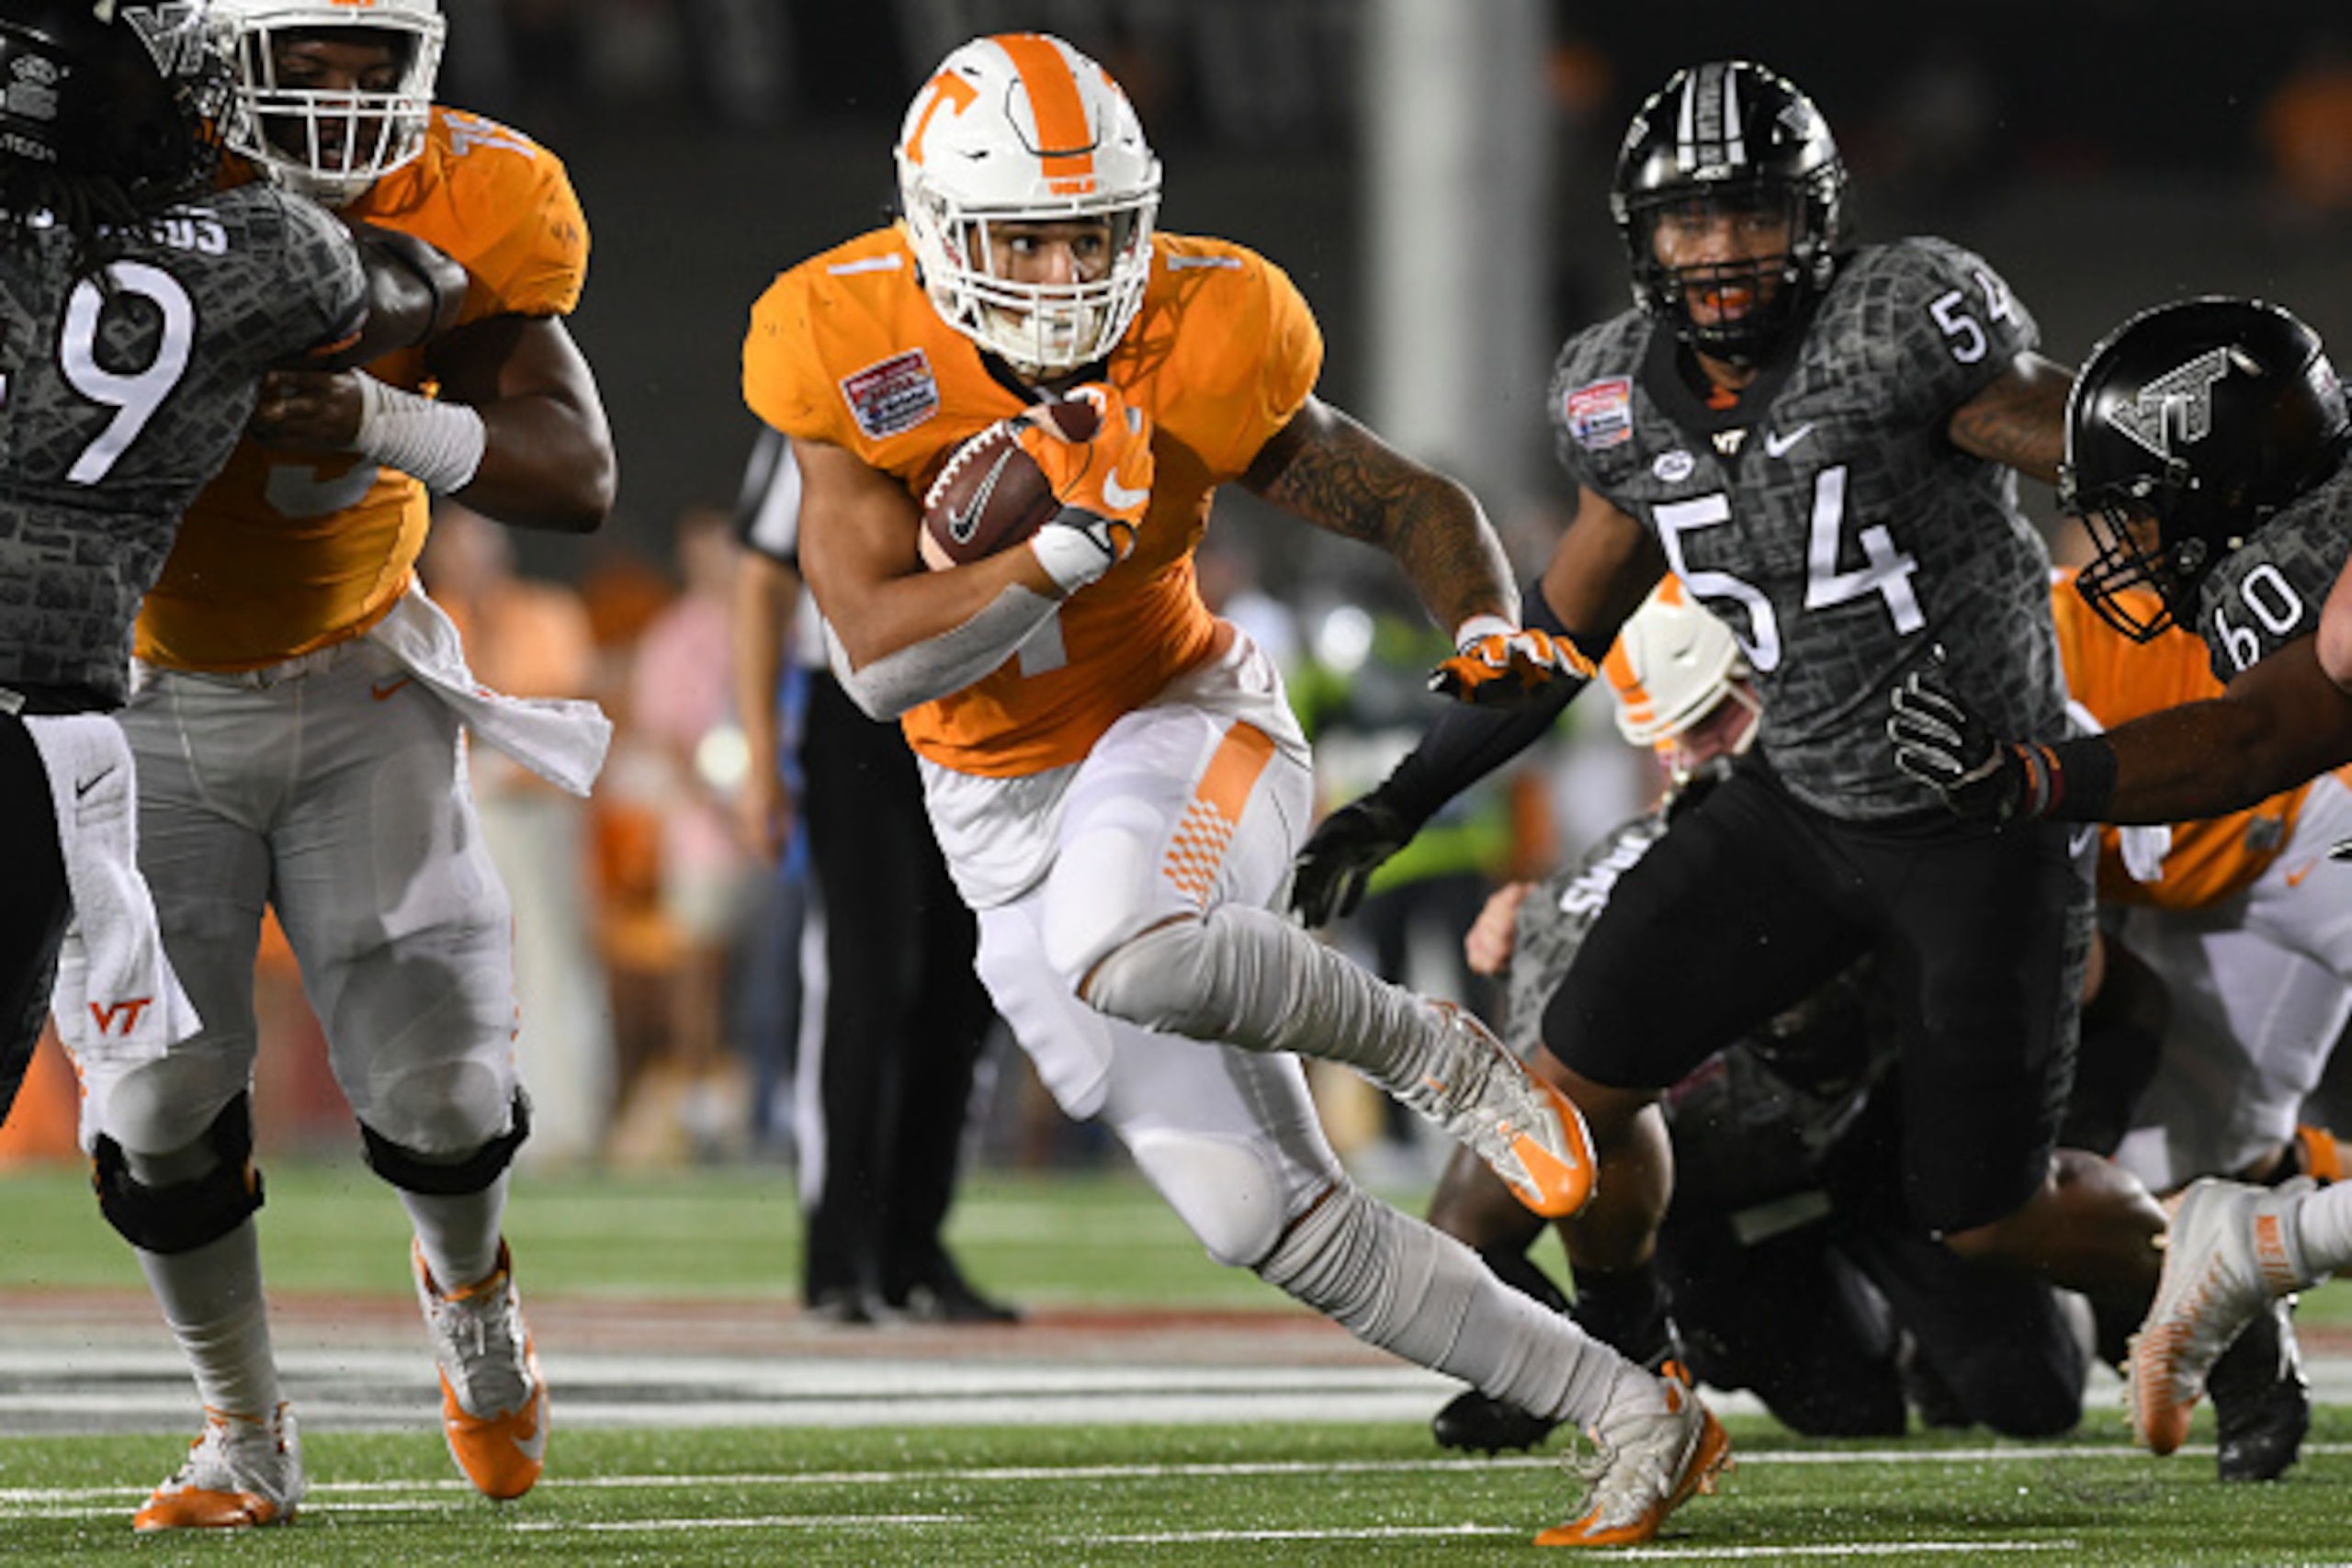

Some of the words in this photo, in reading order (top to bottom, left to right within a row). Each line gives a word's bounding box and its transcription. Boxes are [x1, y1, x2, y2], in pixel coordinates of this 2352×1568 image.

[1929, 270, 2020, 363] 54
[1652, 464, 1927, 672] 54
[2215, 564, 2303, 672] 60
[88, 997, 153, 1036] VT
